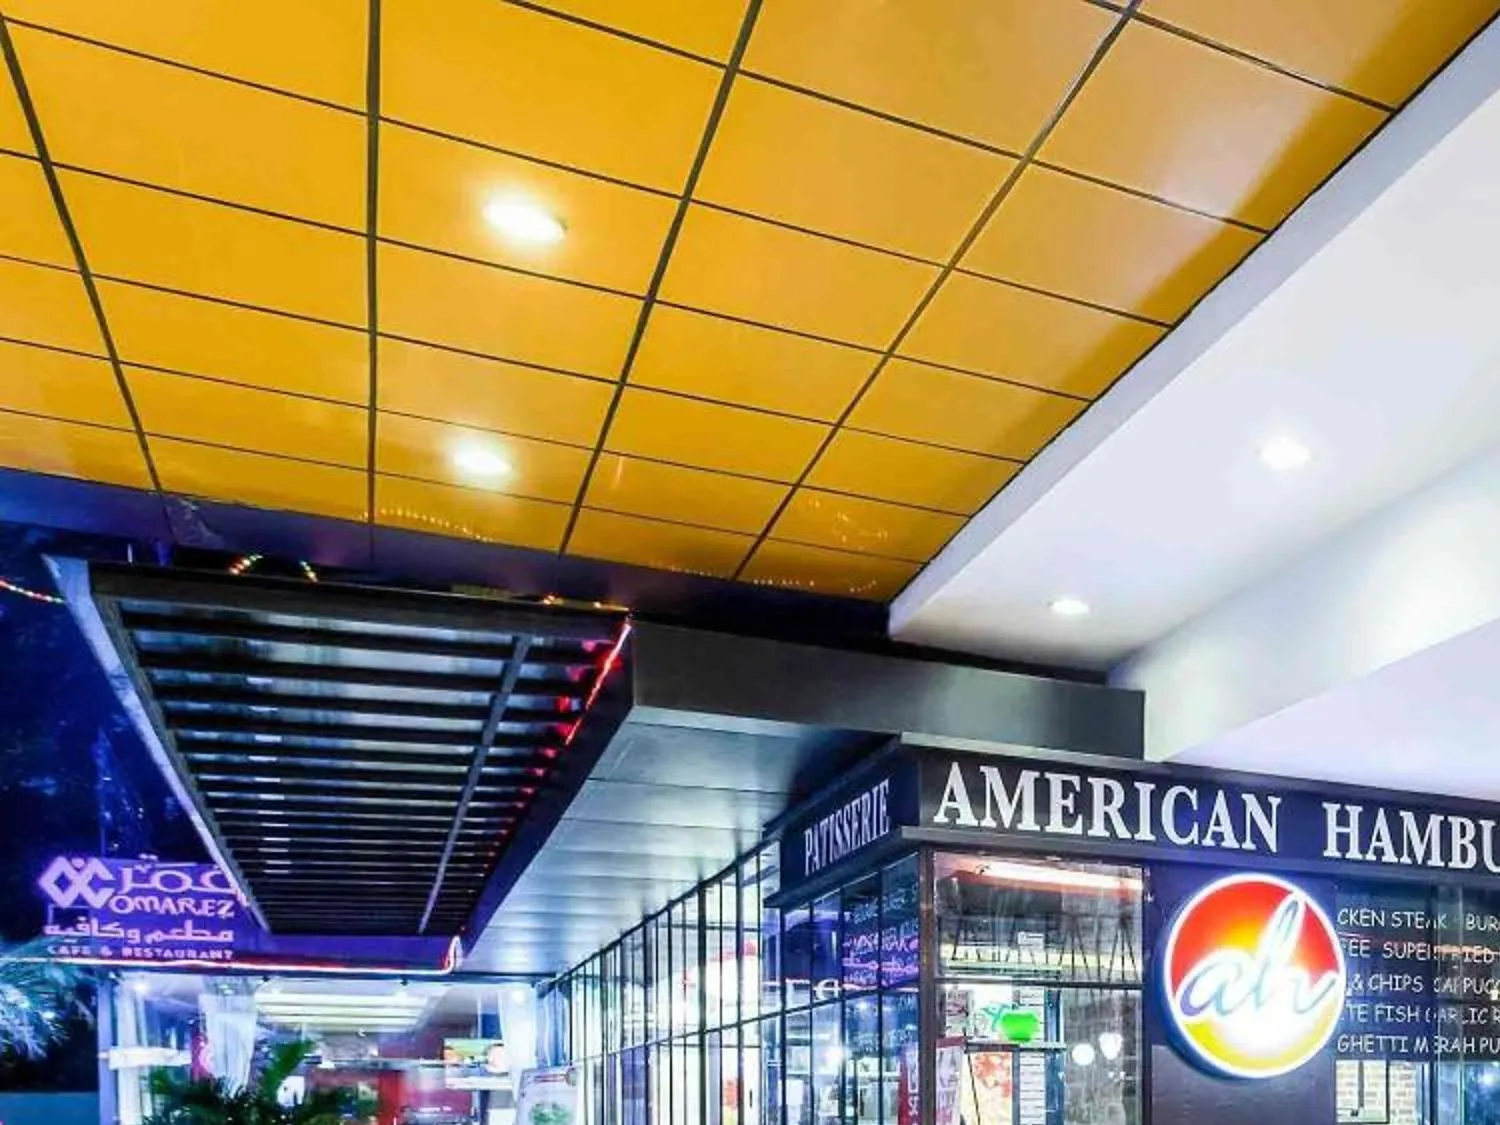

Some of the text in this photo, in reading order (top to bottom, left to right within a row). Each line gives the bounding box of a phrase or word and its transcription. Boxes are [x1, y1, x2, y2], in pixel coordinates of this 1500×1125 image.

[933, 761, 1281, 852] AMERICAN
[804, 778, 890, 877] PATISSERIE
[109, 895, 235, 917] OMAREZ
[121, 947, 233, 960] RESTAURANT
[1368, 973, 1424, 993] CHIPS
[1374, 1004, 1420, 1023] FISH
[1413, 1035, 1475, 1054] MERAH
